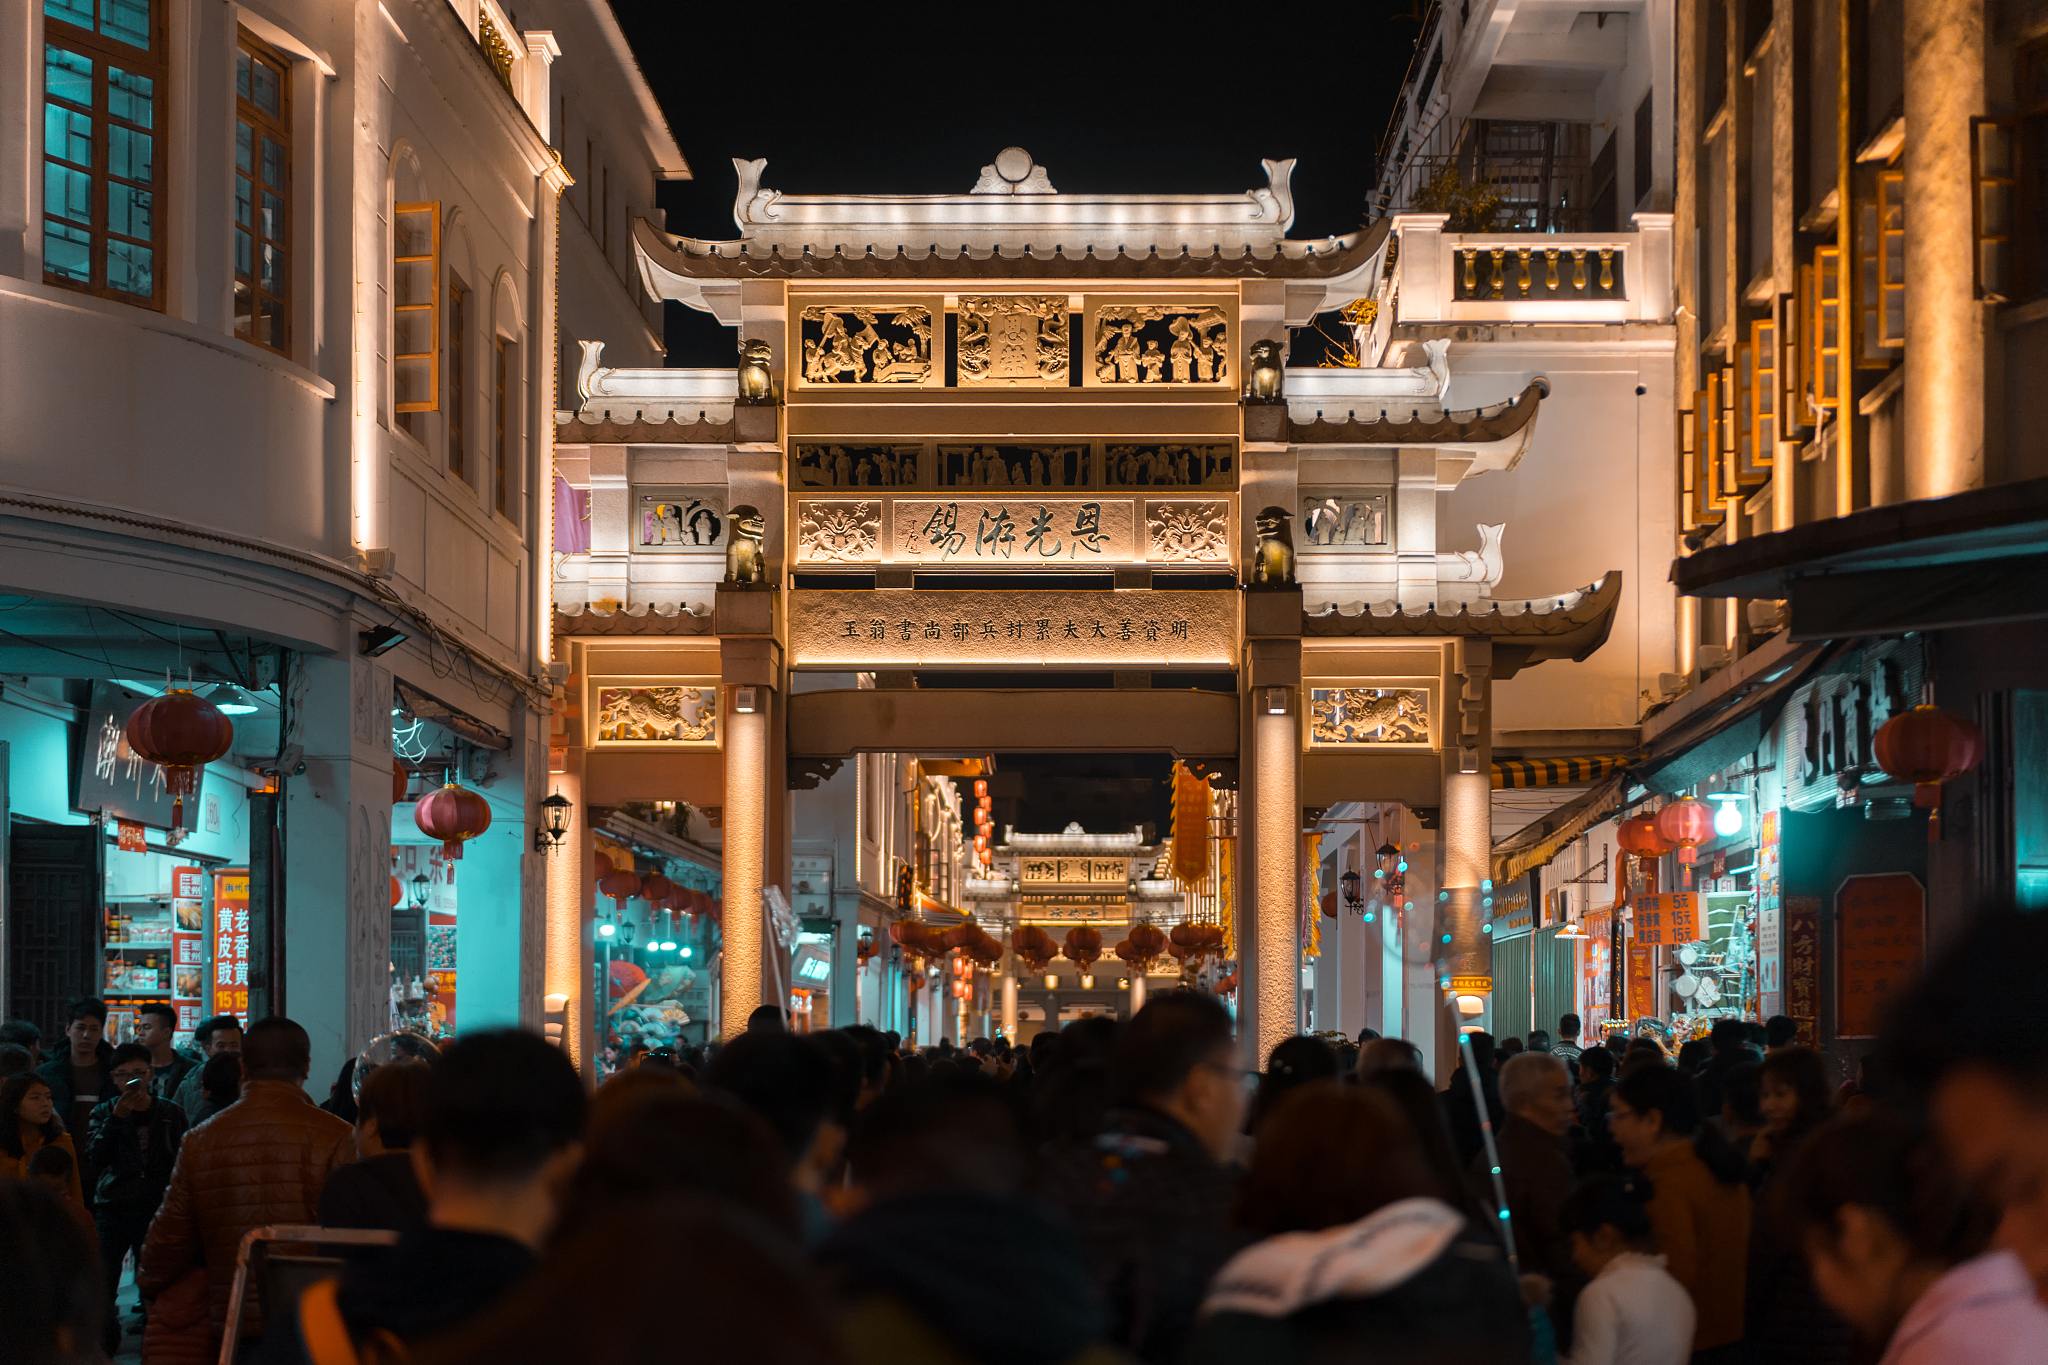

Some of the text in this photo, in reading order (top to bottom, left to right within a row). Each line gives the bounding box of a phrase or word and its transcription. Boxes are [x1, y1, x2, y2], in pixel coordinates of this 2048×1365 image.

[1673, 894, 1689, 909] 5元
[1671, 910, 1692, 926] 15元
[1672, 927, 1692, 942] 15元
[234, 908, 250, 986] 老香黄
[1792, 918, 1815, 1046] 八方財寶進門
